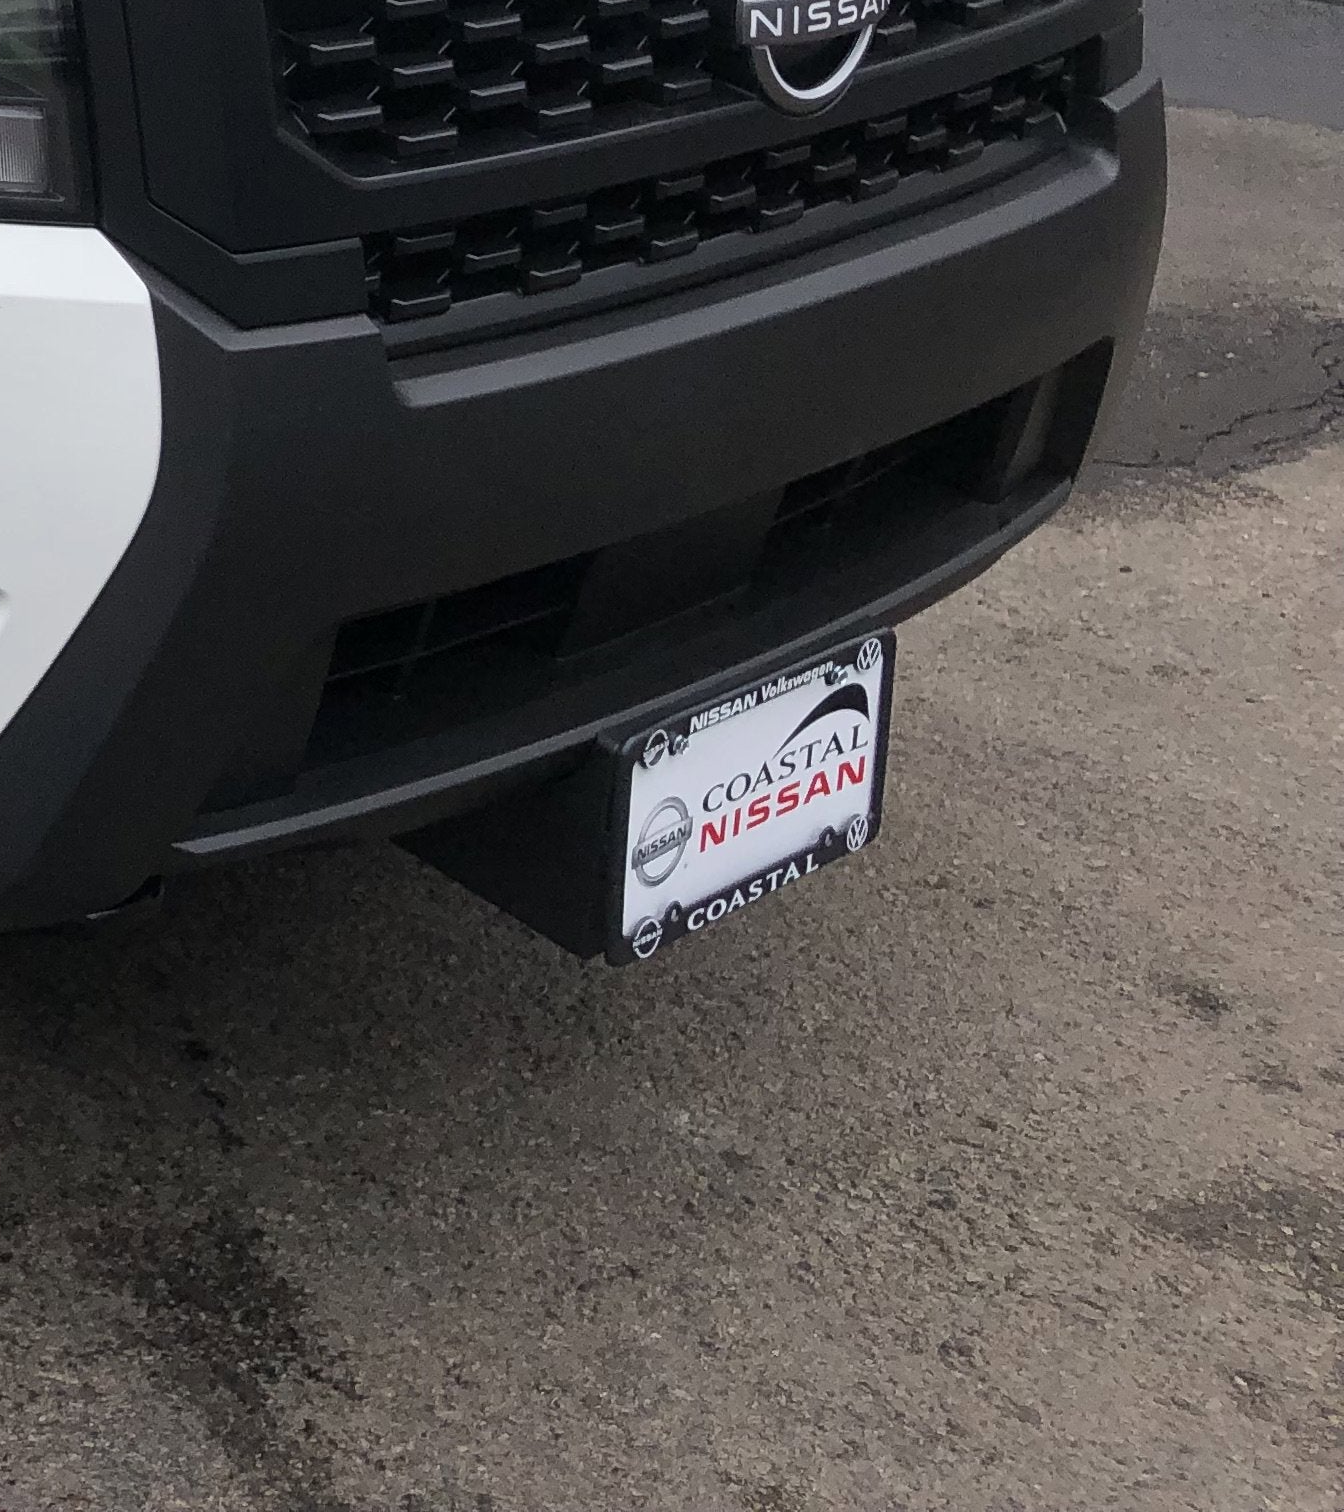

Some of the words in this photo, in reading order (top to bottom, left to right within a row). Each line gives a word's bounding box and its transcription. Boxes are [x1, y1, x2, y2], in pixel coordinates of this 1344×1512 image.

[689, 691, 758, 733] NISSAN
[761, 660, 834, 704] Volkswagen
[699, 755, 866, 853] NISSAN
[702, 723, 869, 813] COASTAL
[637, 824, 688, 860] NISSAN
[687, 852, 819, 931] COASTAL
